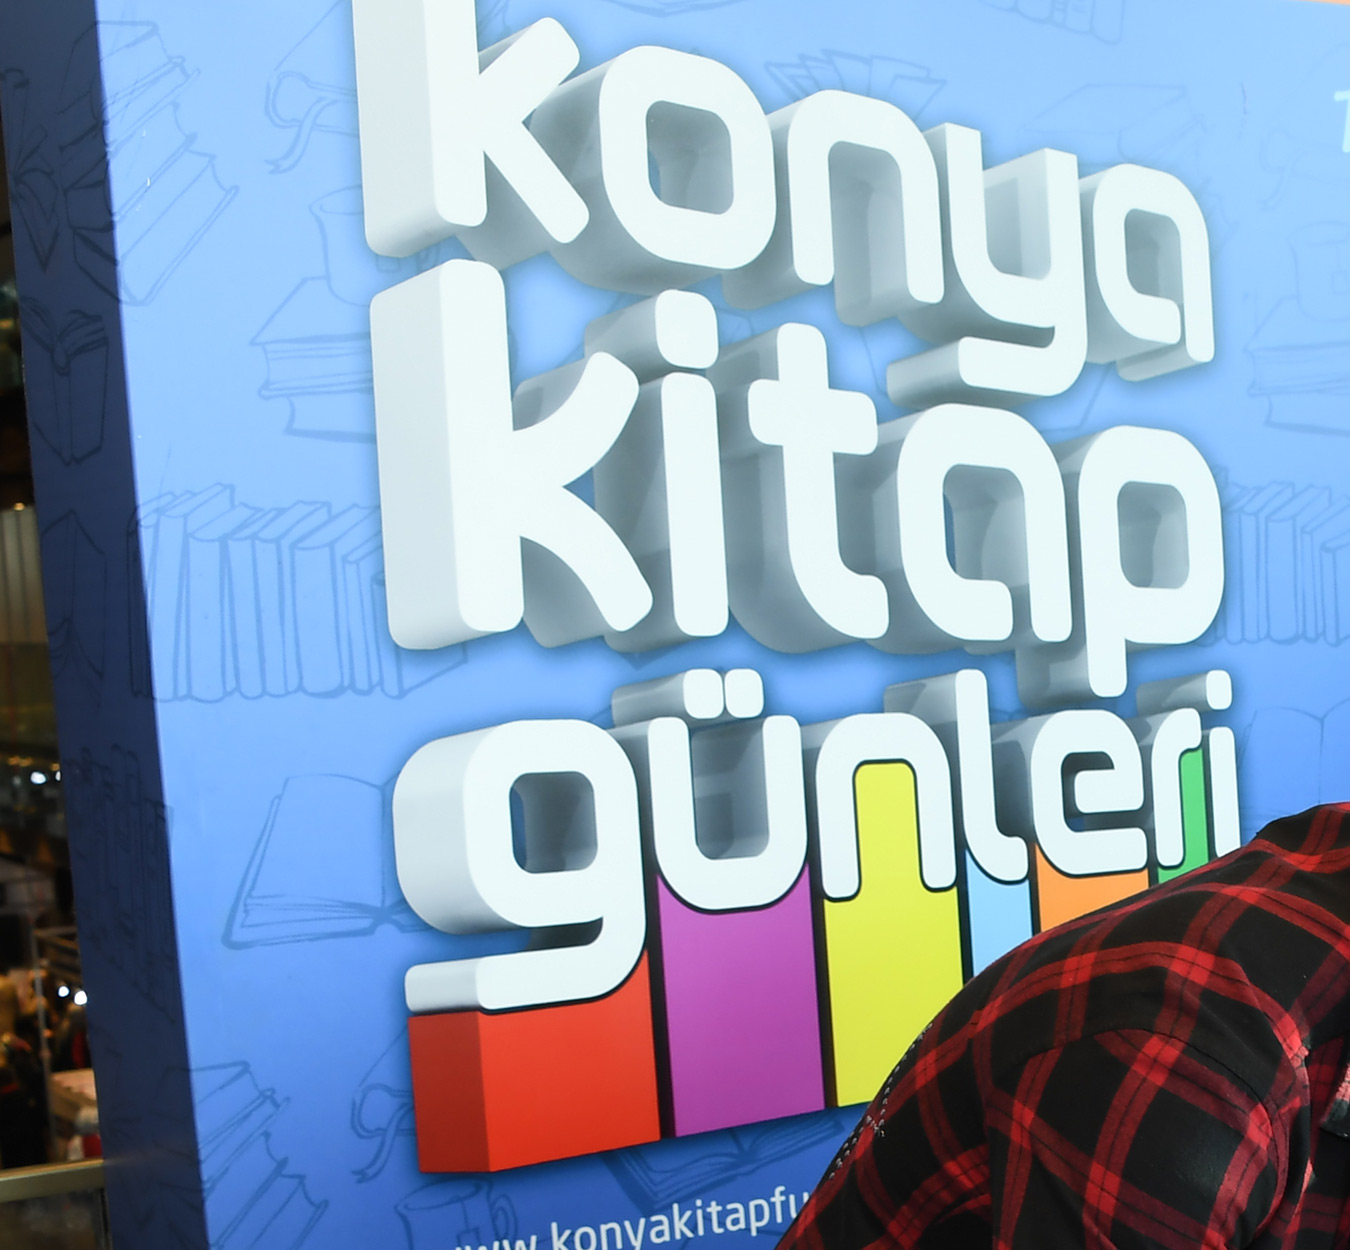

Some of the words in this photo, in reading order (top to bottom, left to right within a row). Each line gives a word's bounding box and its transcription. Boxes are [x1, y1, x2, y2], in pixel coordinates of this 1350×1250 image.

[362, 0, 1216, 398] konya
[370, 257, 1225, 698] kitap
[393, 668, 1241, 1011] günleri
